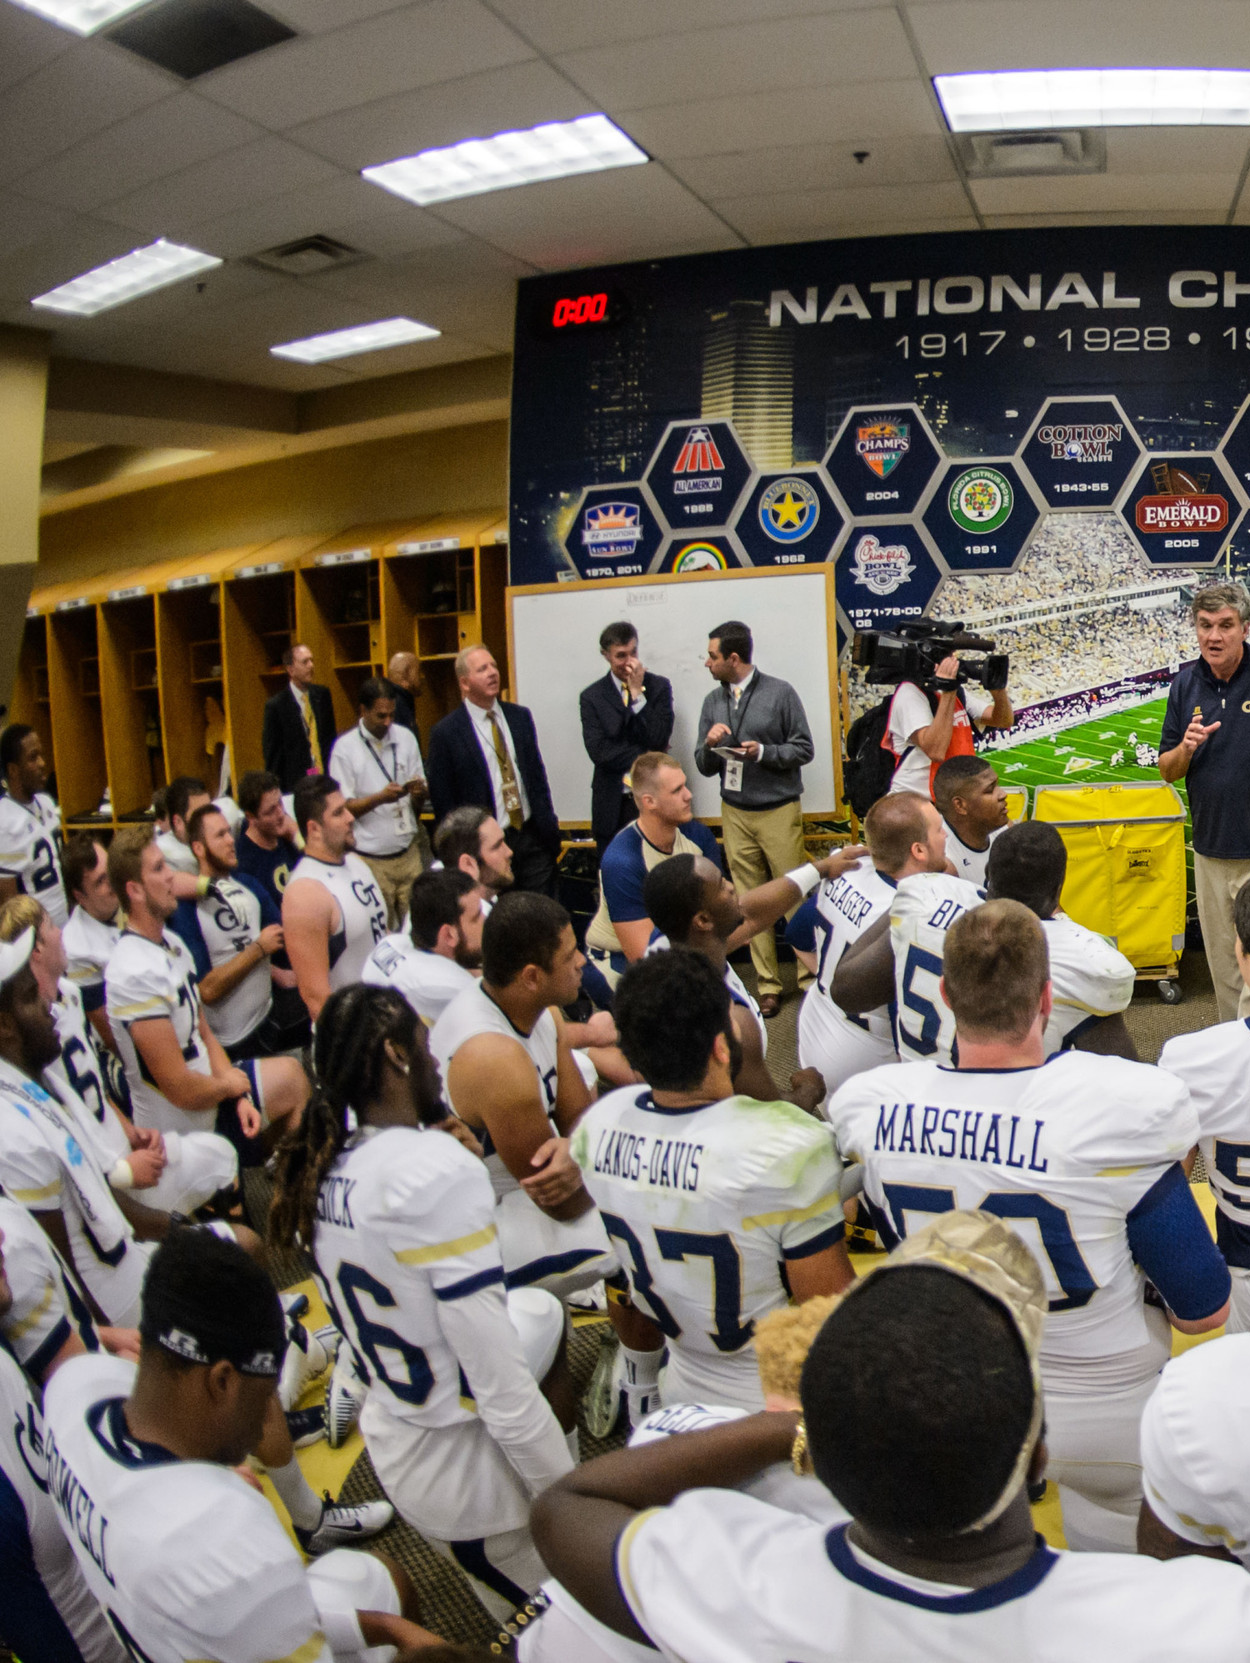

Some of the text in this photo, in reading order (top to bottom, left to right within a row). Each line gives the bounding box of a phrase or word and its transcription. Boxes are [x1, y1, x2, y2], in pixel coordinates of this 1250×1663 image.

[768, 271, 1141, 328] NATIONAL
[552, 293, 608, 328] 0:00
[895, 330, 1007, 361] 1917
[1057, 326, 1171, 353] 1928
[1038, 424, 1123, 443] COTTON
[857, 437, 909, 453] CHAMPS
[1052, 442, 1112, 459] BOWL
[868, 453, 898, 461] BOWL
[866, 491, 900, 501] 2004
[1144, 504, 1221, 524] EMERALD
[1158, 519, 1207, 528] BOWL
[964, 545, 997, 554] 1991
[1165, 540, 1200, 548] 2005
[774, 554, 806, 564] 1962
[617, 565, 643, 575] 2011
[864, 562, 902, 571] BOWL
[856, 619, 873, 628] 08
[824, 878, 873, 929] SEAGER
[873, 1103, 1049, 1174] MARSHALL
